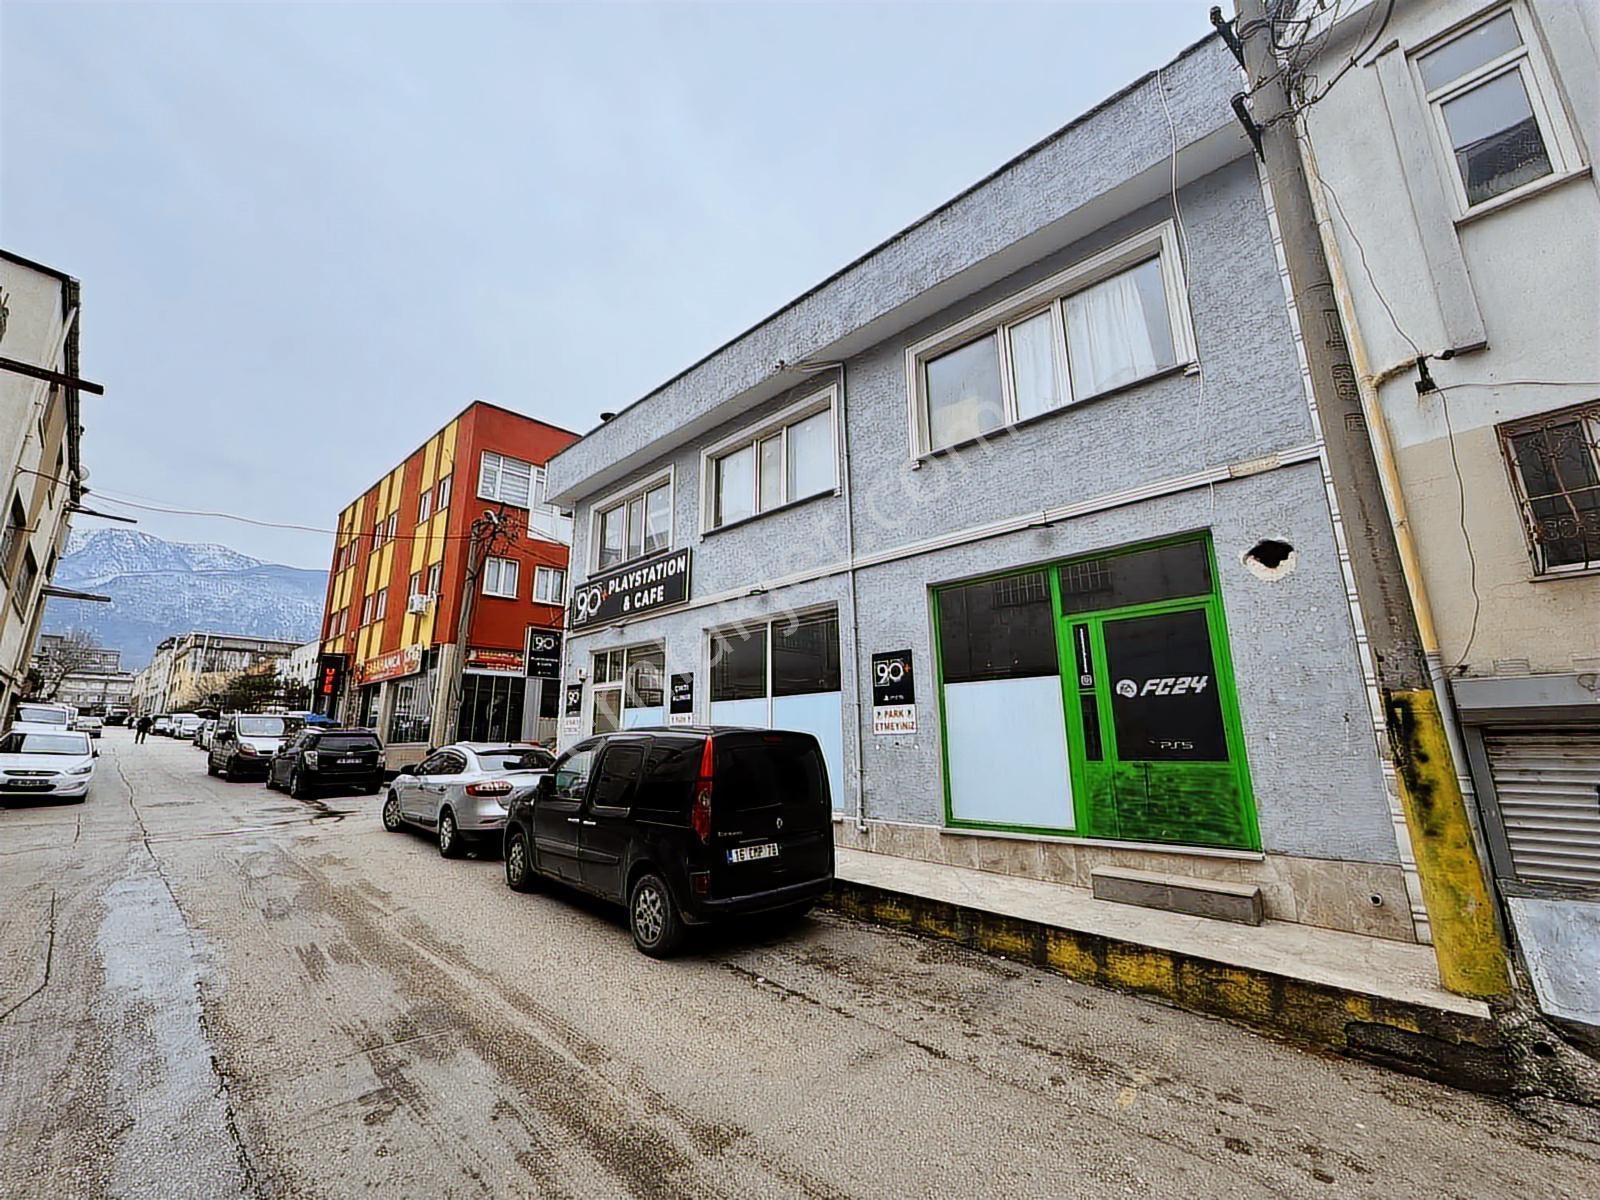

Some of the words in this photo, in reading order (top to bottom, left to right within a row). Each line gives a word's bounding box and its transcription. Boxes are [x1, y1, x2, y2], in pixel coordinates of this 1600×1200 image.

[608, 555, 686, 595] PLAYSTATION
[622, 595, 631, 612] &
[634, 585, 665, 610] CAFE
[1139, 675, 1209, 697] FC24
[884, 710, 905, 719] PARK
